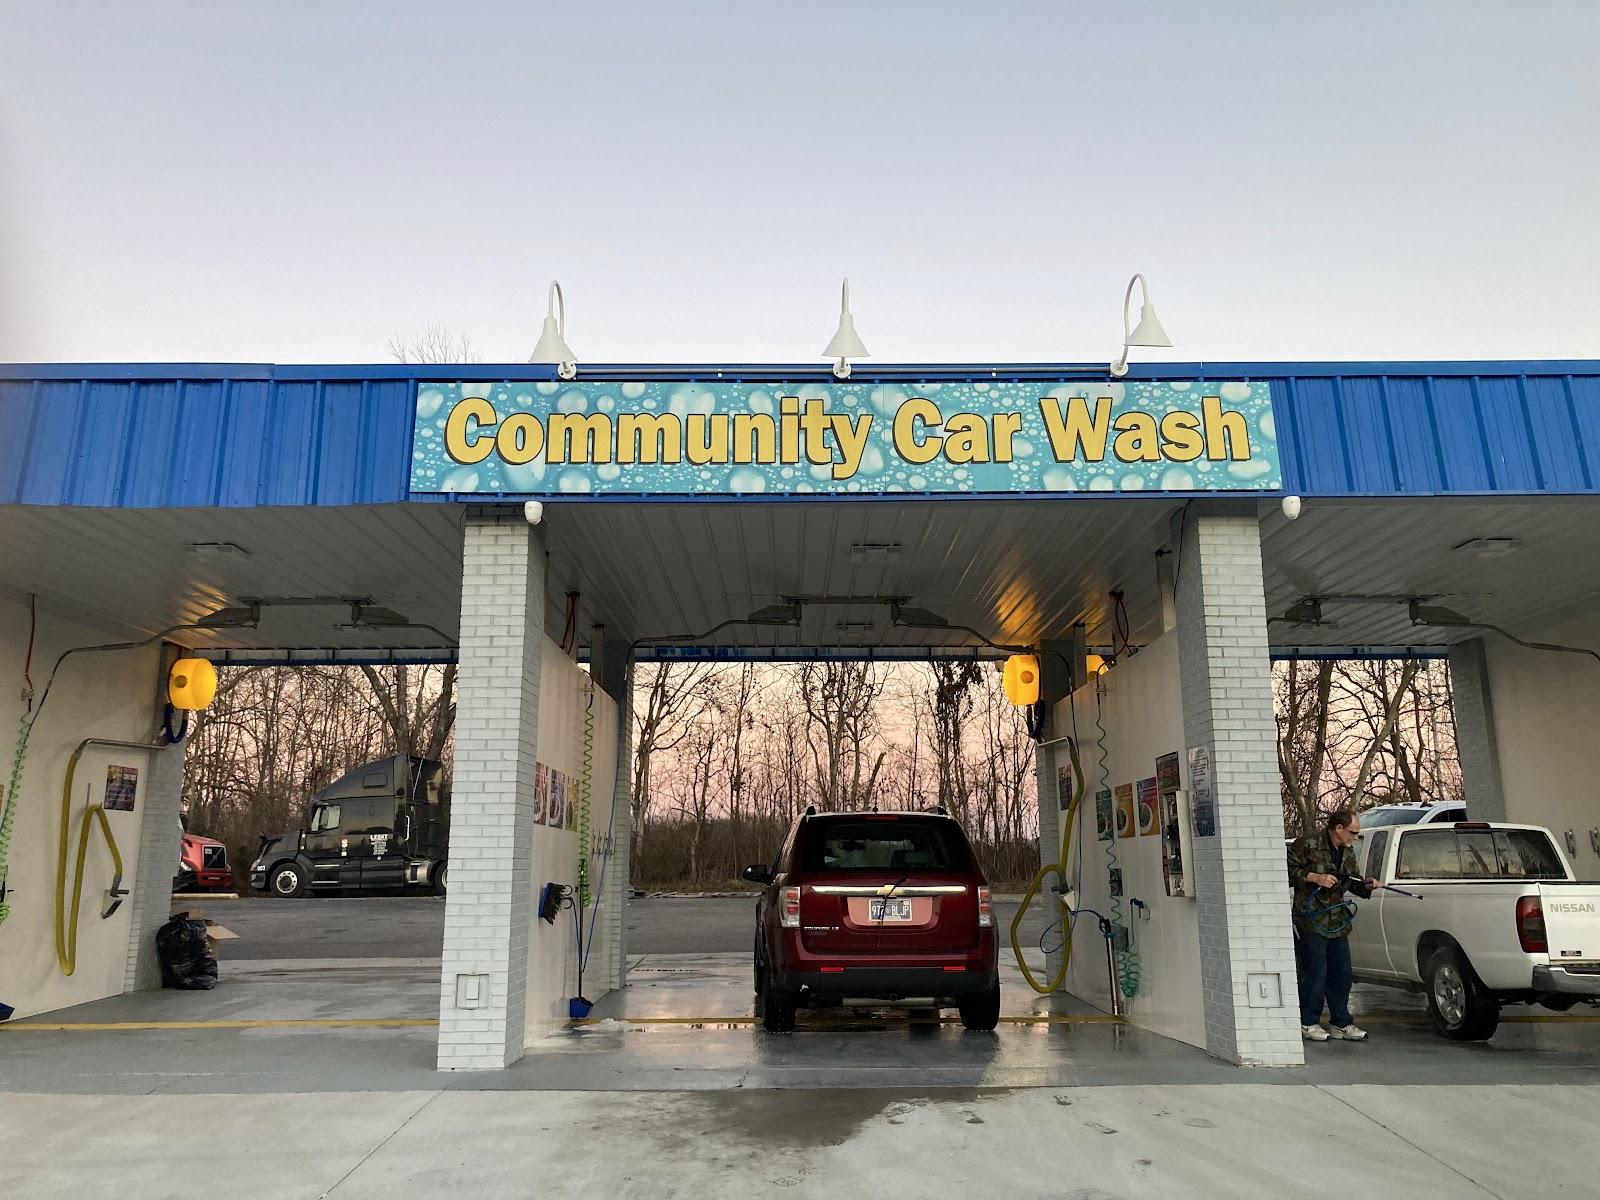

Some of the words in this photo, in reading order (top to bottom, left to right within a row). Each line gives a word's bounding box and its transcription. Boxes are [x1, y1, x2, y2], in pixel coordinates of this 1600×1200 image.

[444, 397, 873, 480] Community
[893, 397, 1021, 464] Car
[1038, 396, 1251, 464] Wash
[891, 905, 909, 916] BLJP
[1549, 903, 1596, 912] NISSAN
